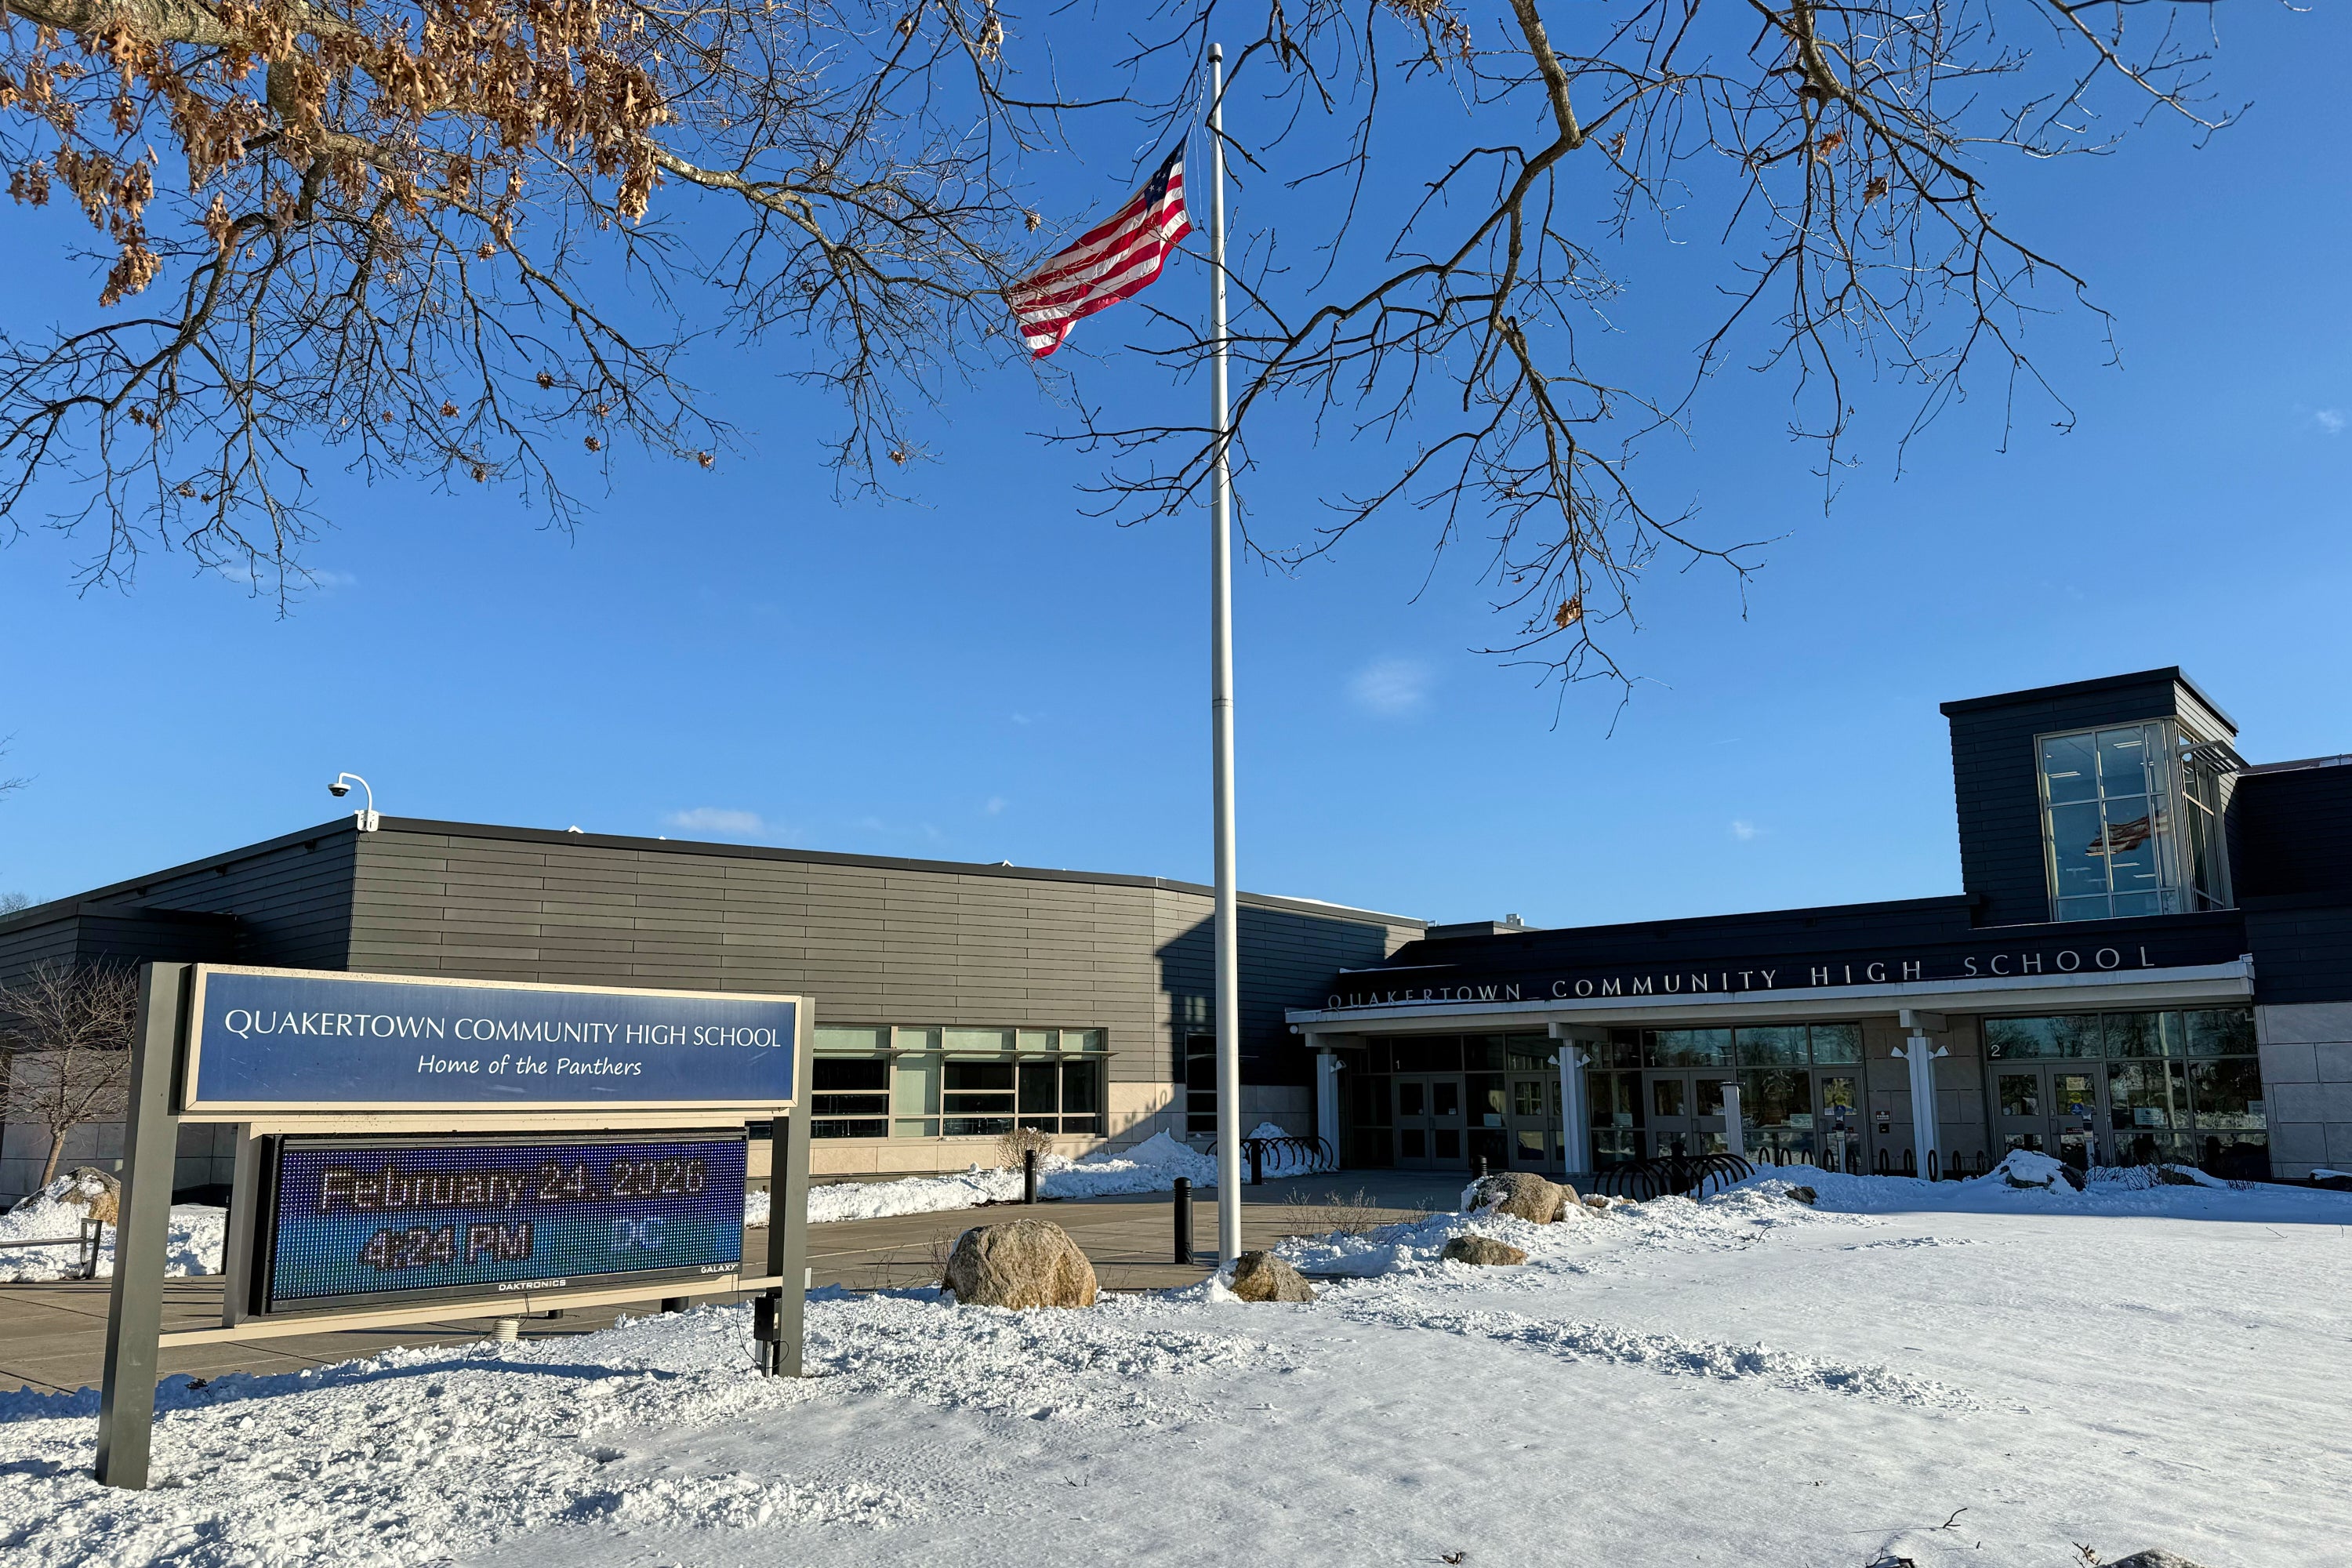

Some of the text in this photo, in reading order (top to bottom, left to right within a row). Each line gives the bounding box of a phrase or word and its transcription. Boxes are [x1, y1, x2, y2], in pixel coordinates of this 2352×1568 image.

[1327, 946, 2155, 1012] QUAKERTOWN COMMUNITY HIGH SCHOOL
[224, 1008, 781, 1047] QUAKERTOWN COMMUNITY HIGH SCHOOL
[417, 1054, 642, 1076] Home of the Panthers
[1990, 1044, 2001, 1058] 2
[322, 1163, 526, 1209] February
[470, 1221, 530, 1264] PM
[701, 1264, 735, 1274] GALAXY
[499, 1279, 566, 1291] DAKTRONICS
